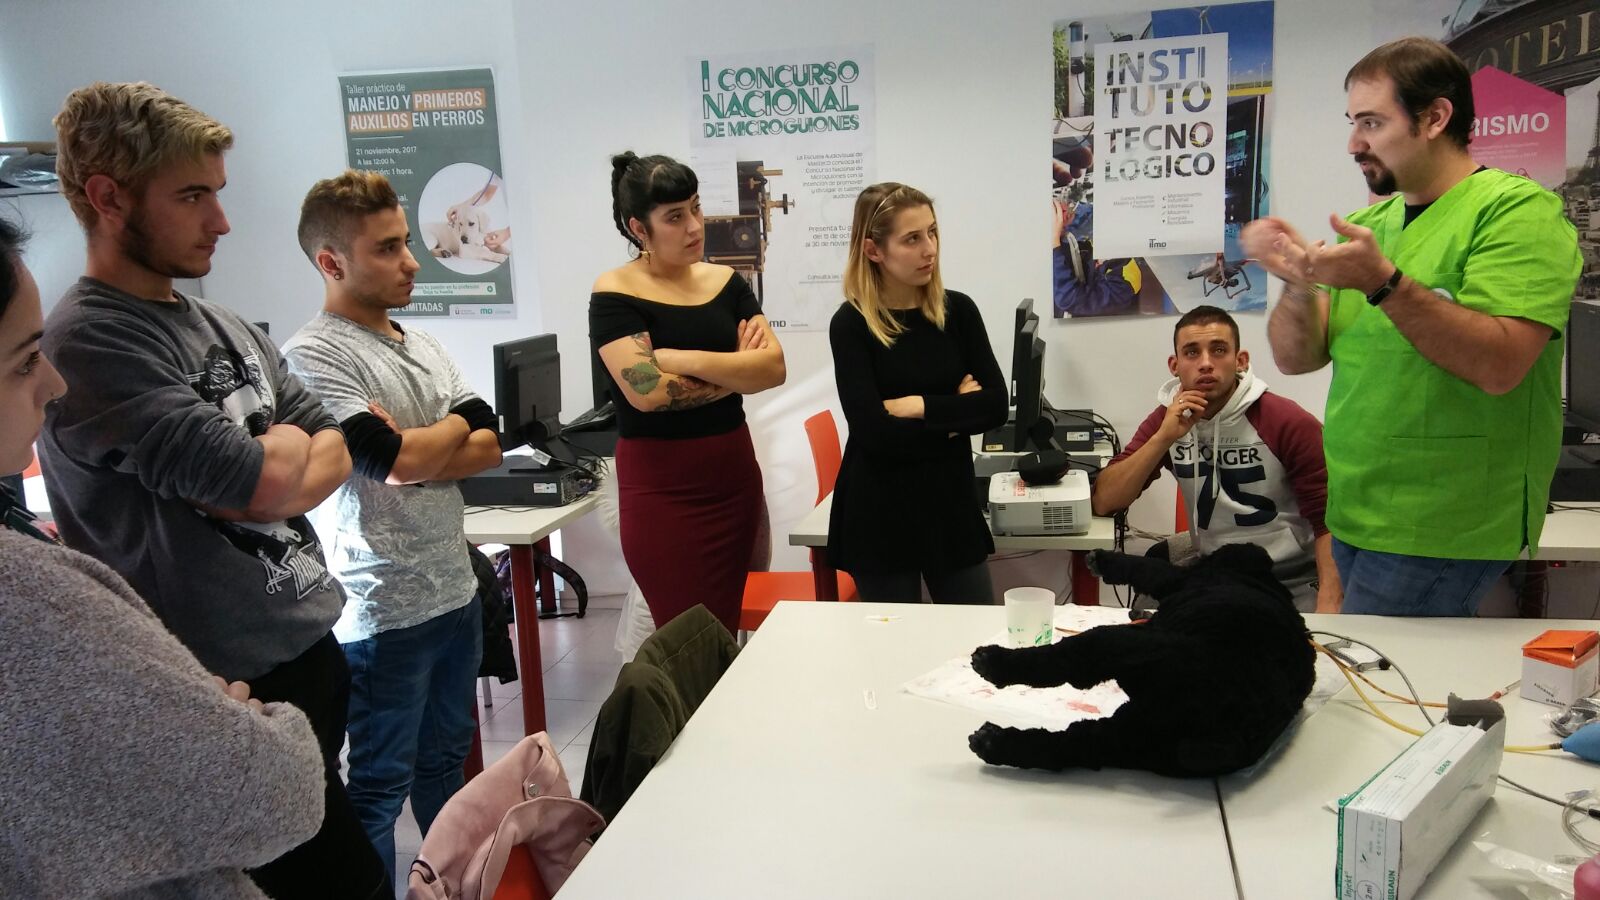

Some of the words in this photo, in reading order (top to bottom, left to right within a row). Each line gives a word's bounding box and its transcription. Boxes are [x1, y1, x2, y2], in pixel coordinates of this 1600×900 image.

[1467, 11, 1600, 76] OTEL
[701, 60, 710, 92] I
[718, 60, 859, 92] CONCURSO
[1106, 46, 1206, 86] INSTI
[346, 84, 364, 94] Taller
[366, 83, 395, 95] práctico
[396, 82, 406, 92] de
[348, 95, 399, 112] MANEJO
[402, 94, 411, 110] Y
[414, 91, 482, 109] PRIMEROS
[702, 85, 859, 119] NACIONAL
[1104, 80, 1212, 119] TUTO
[350, 112, 409, 130] AUXILIOS
[412, 111, 429, 127] EN
[432, 109, 485, 126] PERROS
[703, 121, 725, 138] DE
[728, 114, 859, 136] MICROGUIONES
[1104, 121, 1214, 154] TECNO
[1104, 152, 1215, 183] LOGICO
[1174, 443, 1263, 466] STOGER
